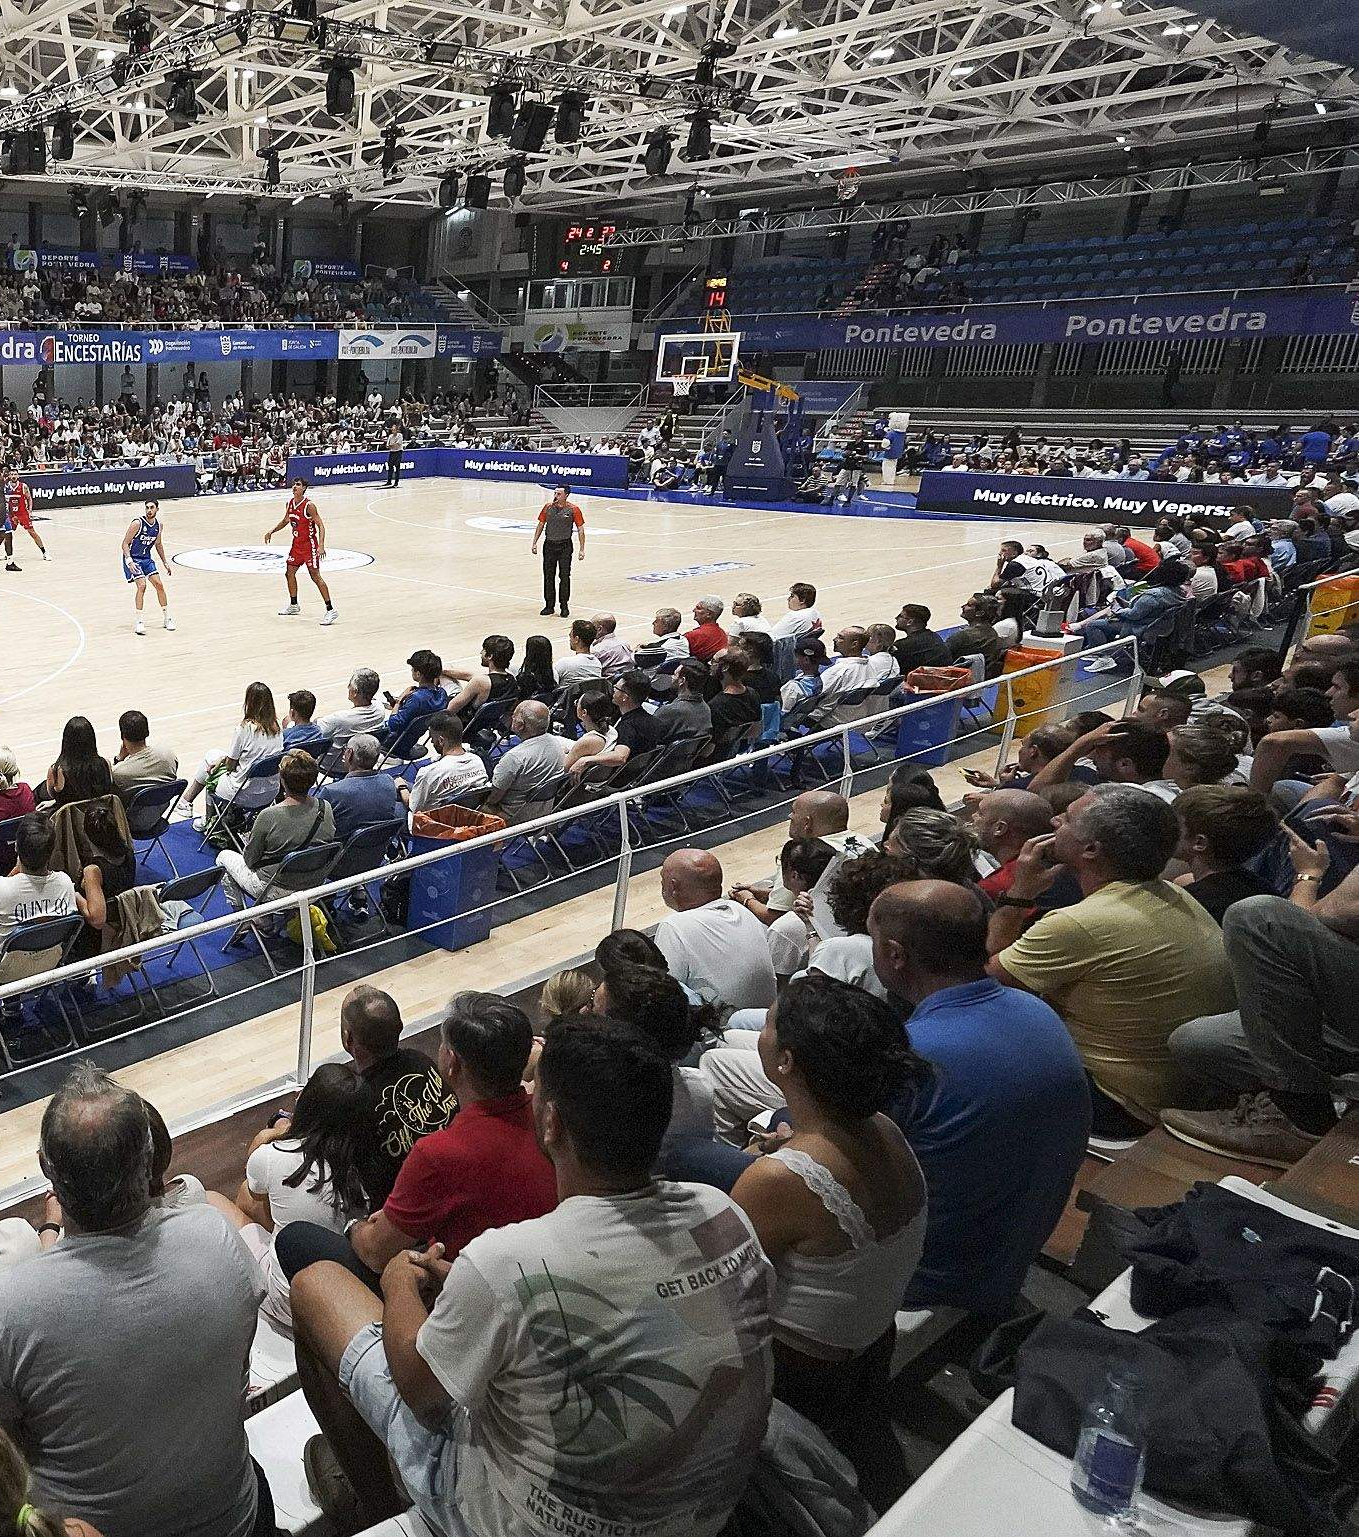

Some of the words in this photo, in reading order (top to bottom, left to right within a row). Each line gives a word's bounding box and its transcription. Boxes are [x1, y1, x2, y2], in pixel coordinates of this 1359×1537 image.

[568, 227, 583, 239] 24
[586, 227, 594, 238] 2
[579, 243, 602, 256] 2:45
[603, 260, 611, 270] 2
[709, 291, 725, 306] 14
[844, 318, 997, 343] Pontevedra
[1064, 306, 1267, 337] Pontevedra
[67, 333, 100, 343] TORNEO
[464, 459, 484, 471] Muy
[528, 463, 549, 475] Muy
[550, 465, 592, 477] Vepersa
[32, 488, 55, 500] Muy
[104, 482, 125, 495] Muy
[127, 480, 165, 492] Vepersa
[973, 488, 1011, 505] Muy
[1014, 492, 1098, 509] eléctrico.
[1102, 496, 1147, 514] Muy
[656, 1279, 685, 1299] GET
[687, 1264, 725, 1291] BACK
[723, 1257, 740, 1273] TO
[530, 1483, 559, 1513] THE
